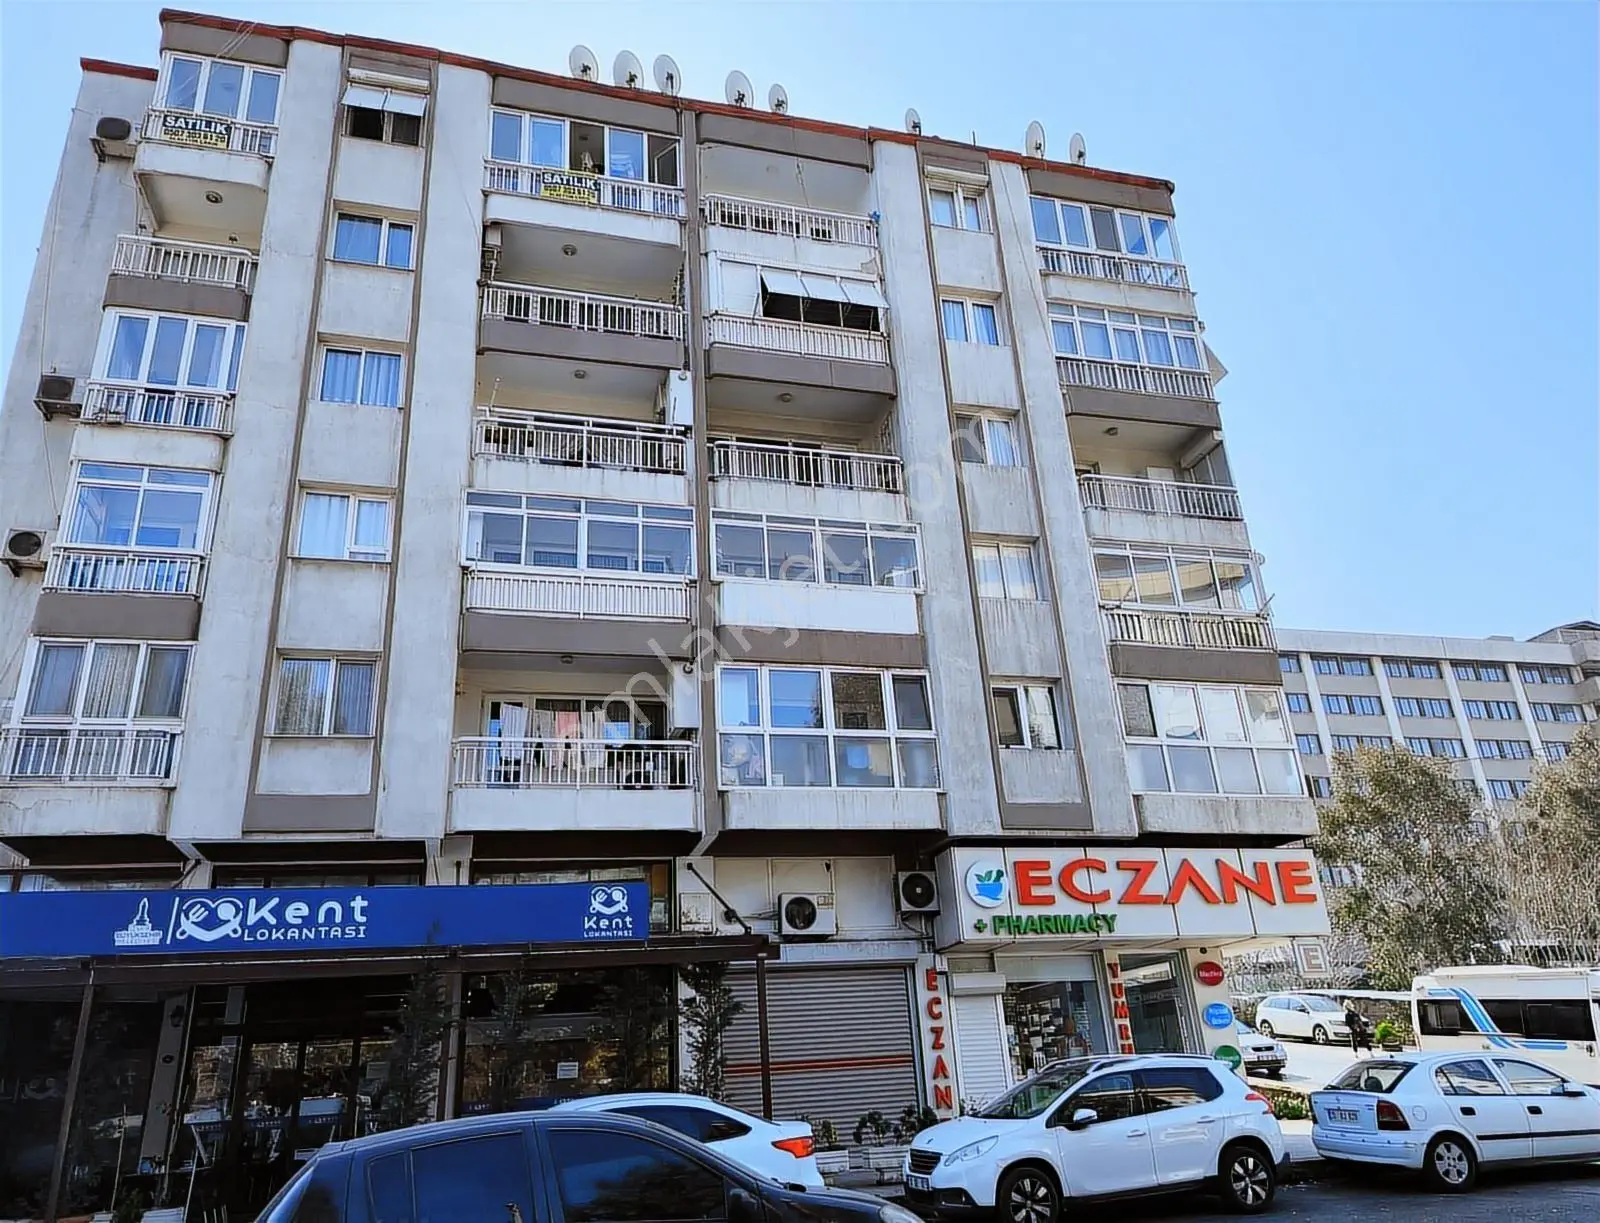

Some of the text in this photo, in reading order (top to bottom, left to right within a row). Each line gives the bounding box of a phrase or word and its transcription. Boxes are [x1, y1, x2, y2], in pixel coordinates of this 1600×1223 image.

[165, 115, 227, 134] SATILIK
[544, 172, 596, 189] SATILIK
[1013, 857, 1318, 906] ECZANE
[246, 895, 369, 925] Kent
[584, 915, 633, 929] Kent
[992, 912, 1118, 935] PHARMACY
[243, 925, 367, 941] LOKANTASI
[925, 967, 953, 1120] ECZAN
